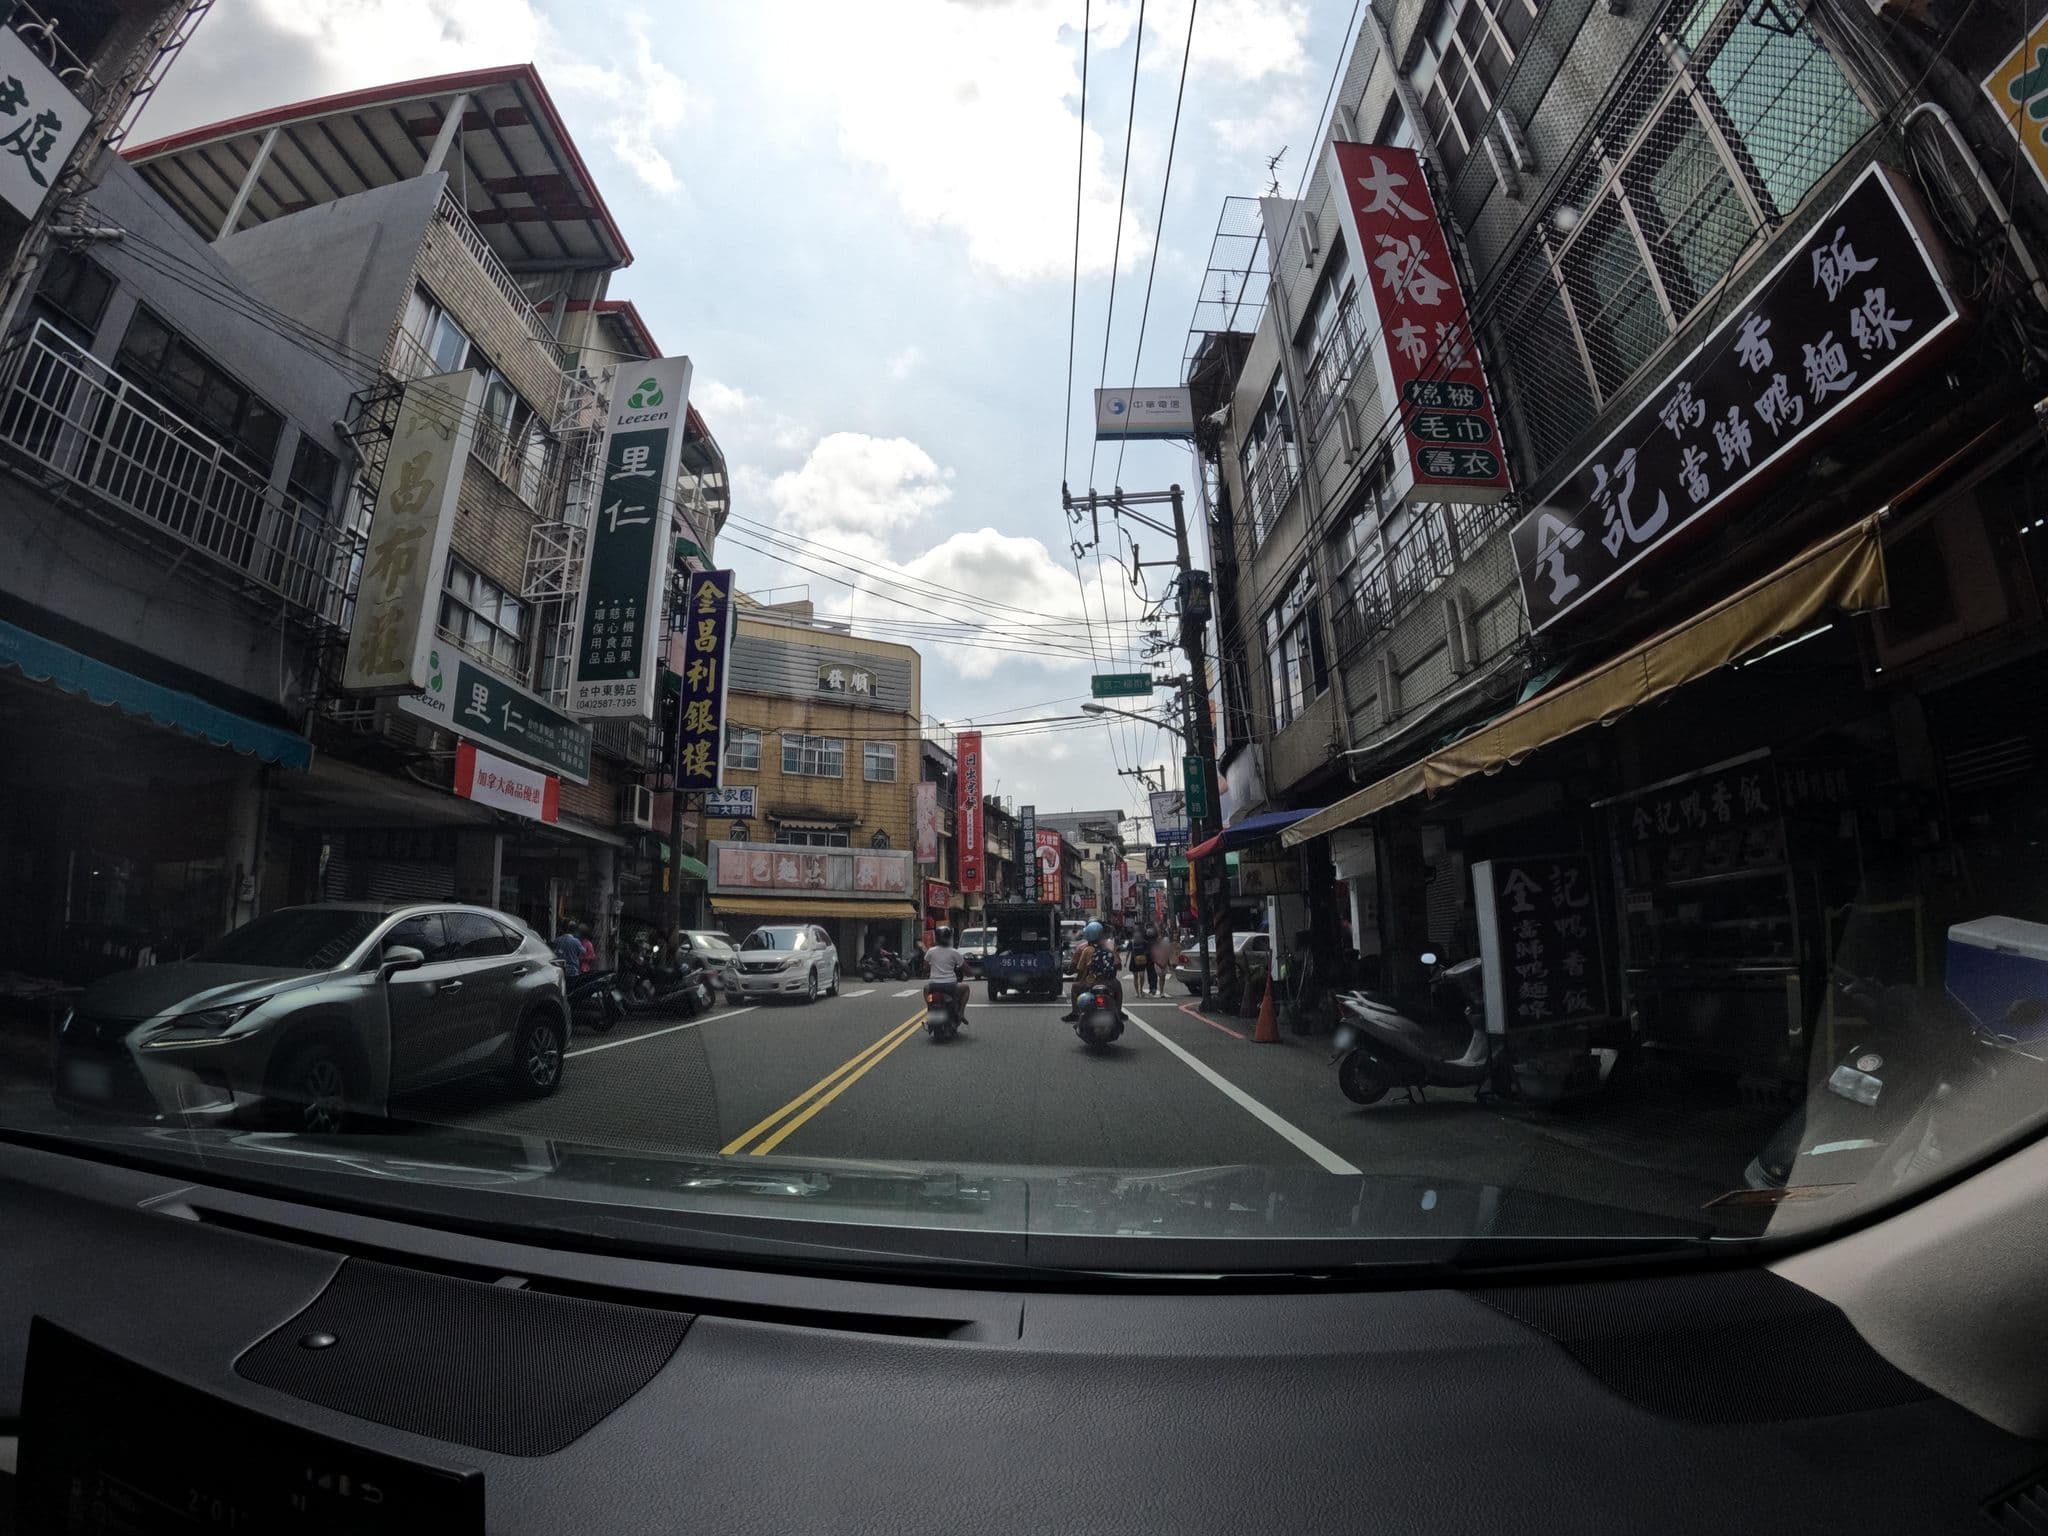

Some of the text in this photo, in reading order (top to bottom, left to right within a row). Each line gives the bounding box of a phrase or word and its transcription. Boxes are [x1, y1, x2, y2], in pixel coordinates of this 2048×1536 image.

[617, 411, 668, 425] Leezen
[1420, 416, 1484, 440] 毛巾
[604, 446, 656, 533] 里仁
[580, 684, 637, 698] 台中東勢店
[464, 682, 526, 733] 里仁
